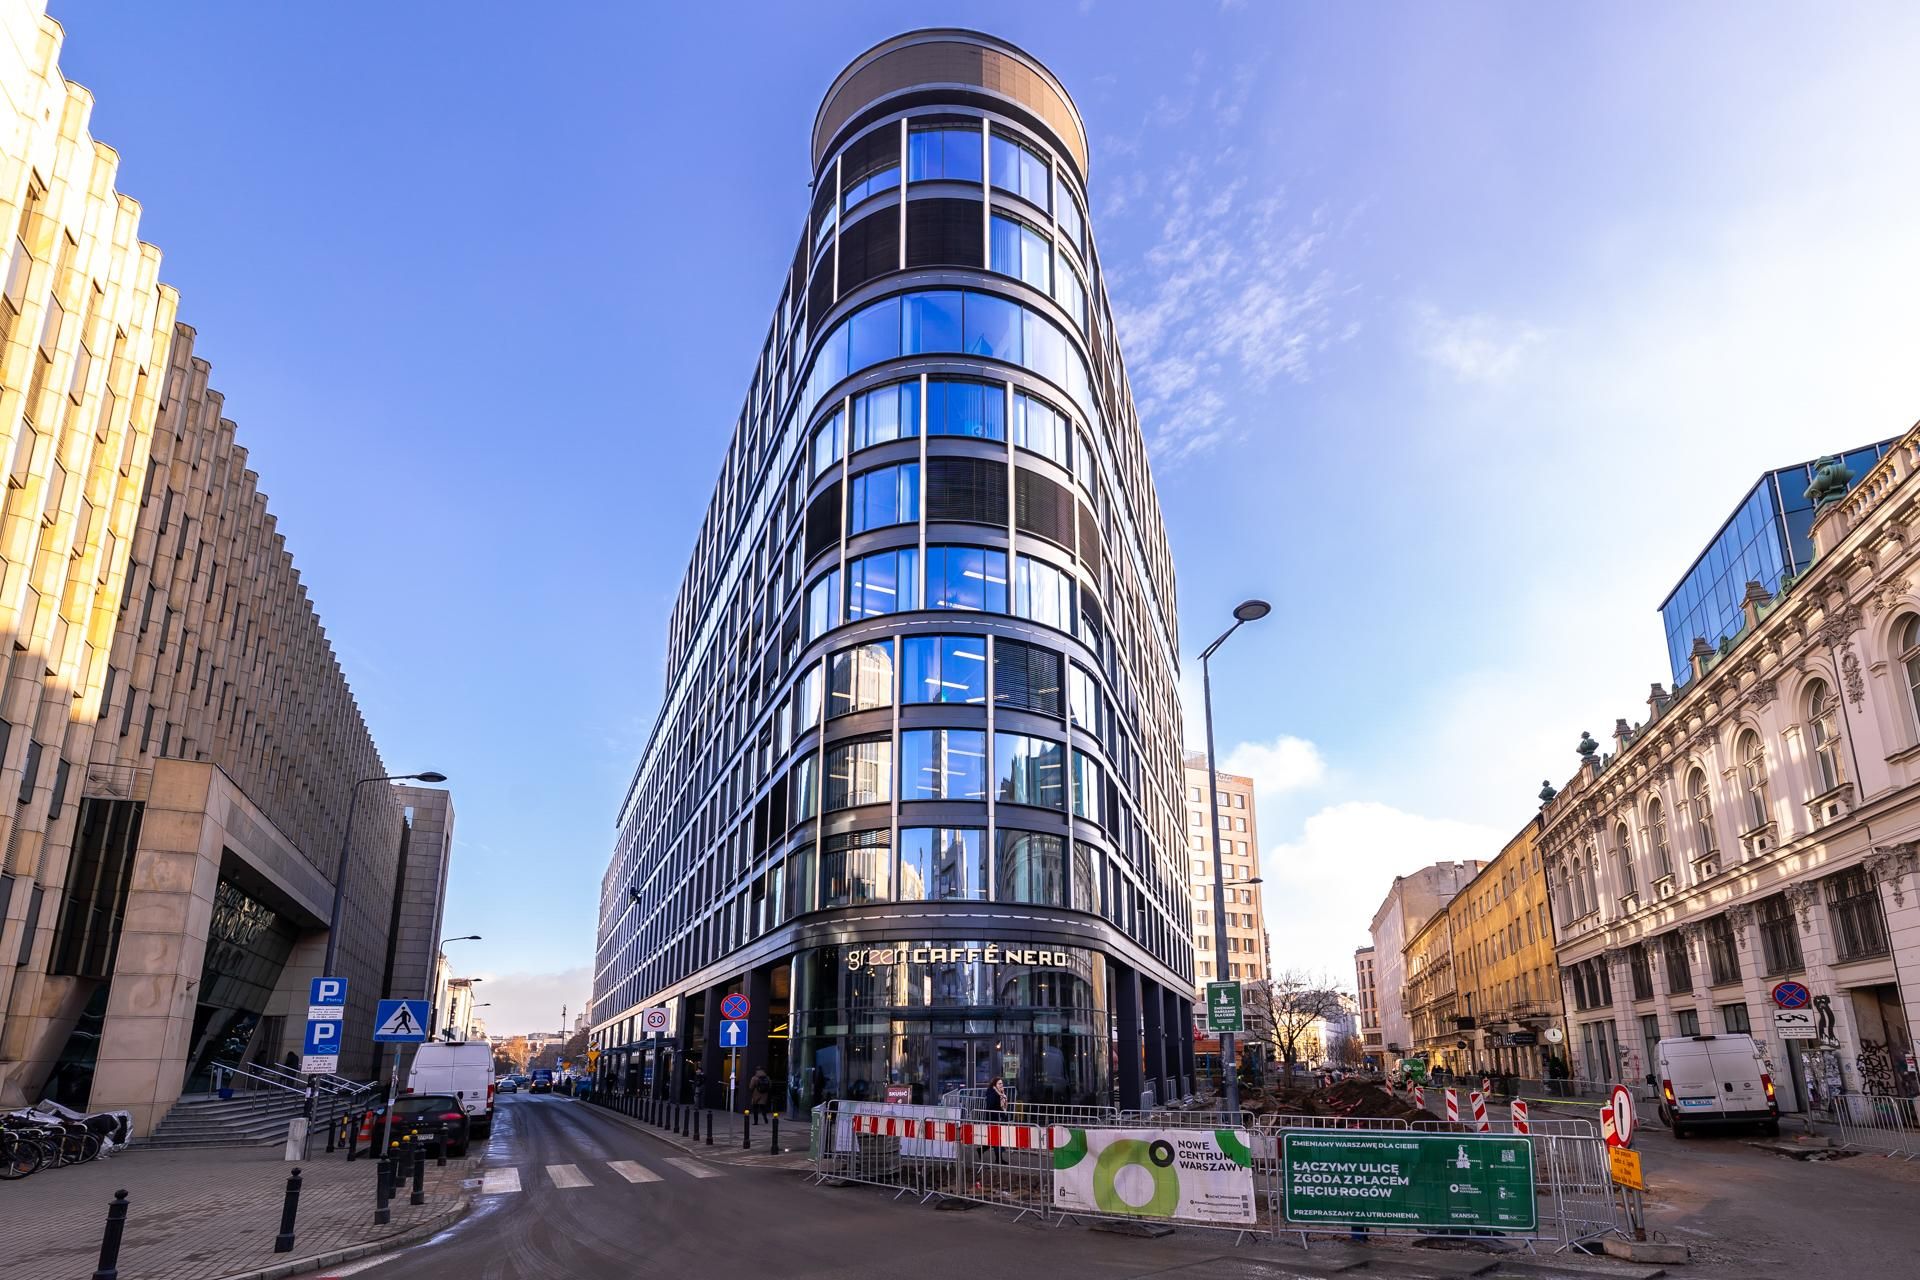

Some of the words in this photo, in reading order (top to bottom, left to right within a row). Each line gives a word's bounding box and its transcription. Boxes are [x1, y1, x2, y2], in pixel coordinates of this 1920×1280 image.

[849, 948, 907, 971] green
[913, 943, 999, 963] CAFFÉ
[1005, 950, 1068, 967] NERO
[318, 980, 339, 1002] P
[650, 1015, 663, 1024] 30
[313, 1023, 335, 1045] P
[1178, 1140, 1210, 1150] NOWE
[1335, 1142, 1377, 1150] WARSZAWĘ
[1179, 1150, 1234, 1160] CENTRUM
[1180, 1161, 1244, 1172] WARSZAWY
[1293, 1161, 1357, 1173] ŁĄCZYMY
[1360, 1163, 1399, 1175] ULICĘ
[1294, 1173, 1342, 1183] ZGODA
[1344, 1175, 1352, 1184] Z
[1355, 1175, 1409, 1186] PLACEM
[1294, 1185, 1338, 1198] PIĘCIU
[1340, 1185, 1392, 1198] ROGÓW
[1294, 1209, 1354, 1217] PRZEPRASZAMY
[1366, 1211, 1420, 1219] UTRUDNIENIA
